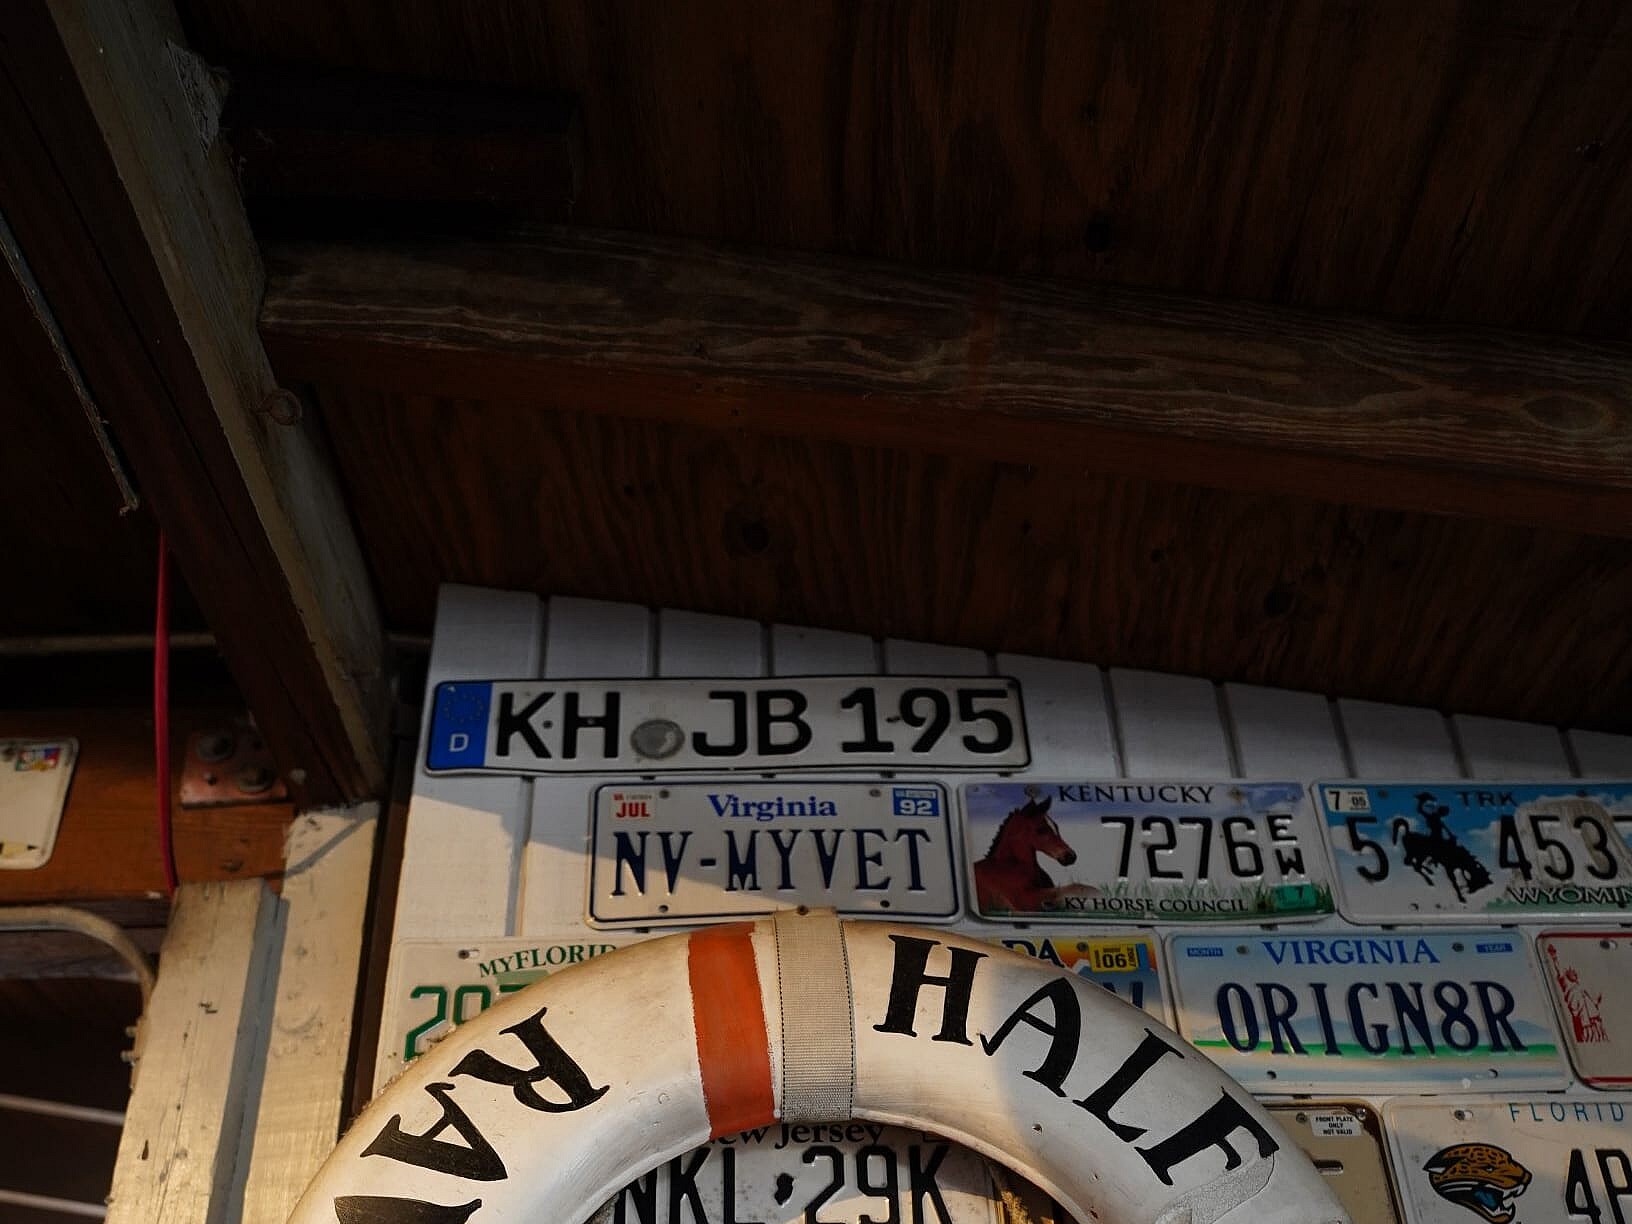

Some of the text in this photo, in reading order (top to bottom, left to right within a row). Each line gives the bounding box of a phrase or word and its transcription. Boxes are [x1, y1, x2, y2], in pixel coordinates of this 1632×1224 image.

[496, 687, 1013, 759] KH JB 195
[449, 733, 469, 752] D
[707, 793, 838, 822] Virginia
[899, 799, 933, 816] 92
[1058, 785, 1215, 804] KENTUCKY
[1456, 790, 1518, 807] TRK
[615, 802, 651, 818] JUL
[1101, 816, 1264, 879] 7276
[609, 828, 931, 896] NV-MYVET
[1064, 897, 1249, 914] KY HORSE COUNCIL
[1102, 953, 1127, 968] 06
[1262, 937, 1440, 966] VIRGINIA
[404, 984, 530, 1061] 20
[872, 934, 1281, 1187] HALF
[774, 1121, 886, 1149] Jersey
